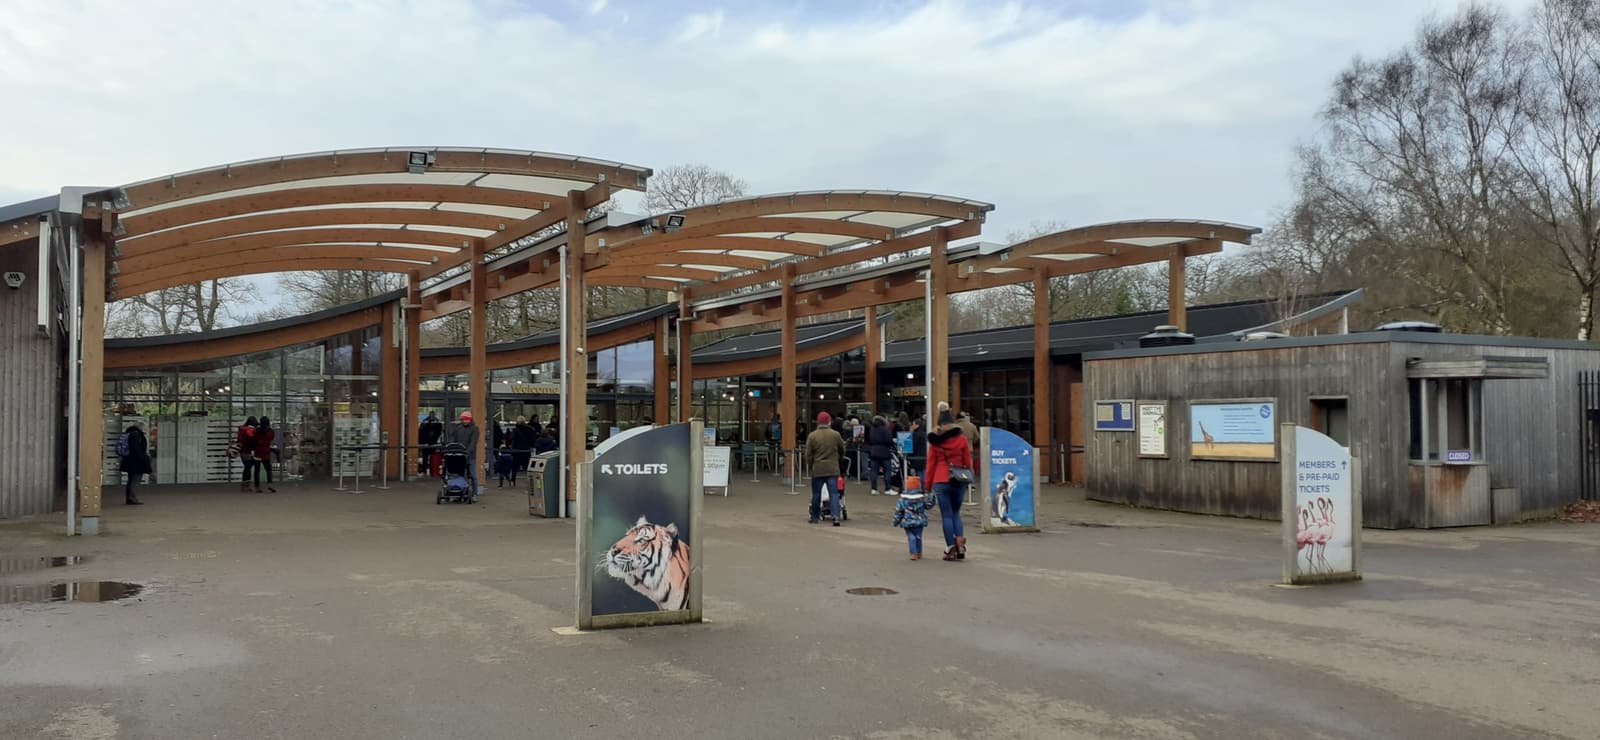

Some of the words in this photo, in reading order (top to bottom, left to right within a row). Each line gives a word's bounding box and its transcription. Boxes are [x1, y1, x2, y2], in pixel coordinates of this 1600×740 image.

[511, 385, 560, 394] Welcome
[991, 449, 1004, 457] BUY
[991, 457, 1017, 465] TICKETS
[1298, 460, 1337, 469] MEMBERS
[614, 463, 668, 475] TOILETS
[1299, 472, 1305, 481] &
[1306, 472, 1340, 481] PRE-PAID
[1298, 485, 1330, 493] TICKETS
